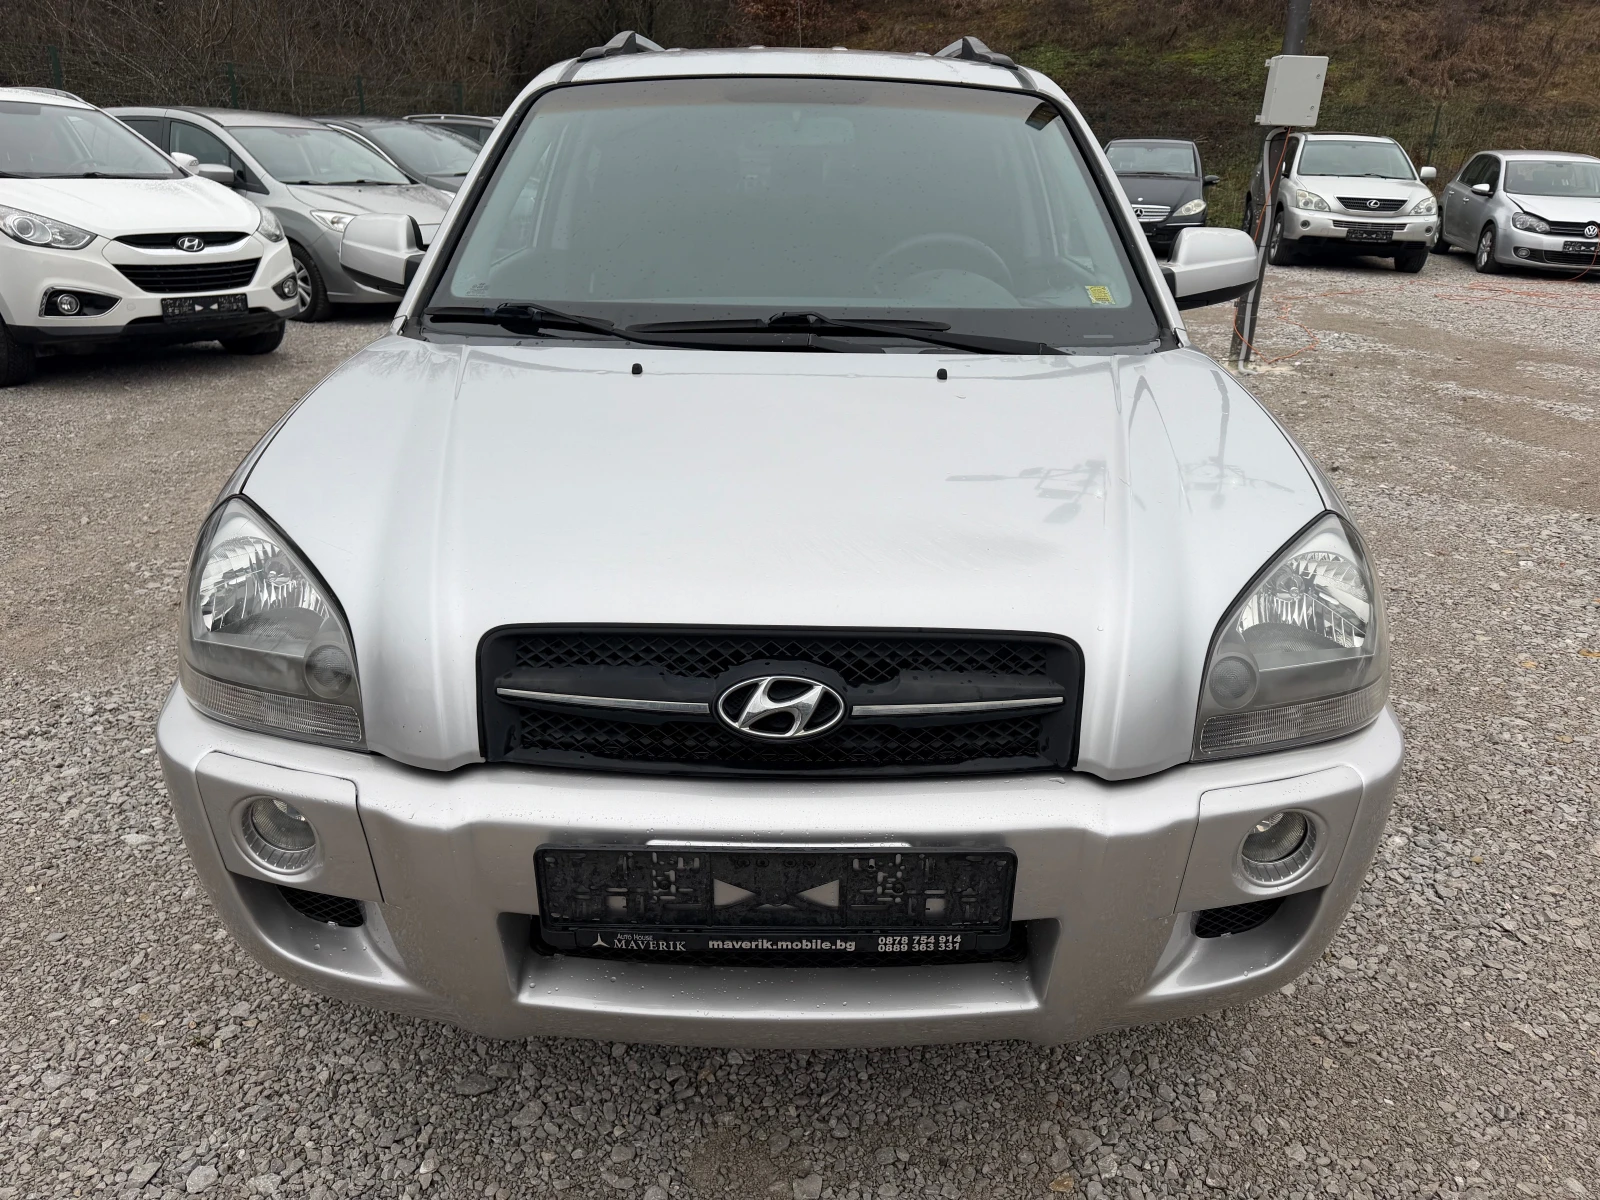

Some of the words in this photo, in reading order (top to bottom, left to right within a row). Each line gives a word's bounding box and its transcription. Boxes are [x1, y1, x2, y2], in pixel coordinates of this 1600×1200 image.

[878, 936, 909, 944] 0878
[912, 935, 935, 944] 754
[938, 934, 961, 943] 914
[613, 939, 686, 951] MAVERIK
[708, 938, 856, 952] maverik.mobile.bg
[878, 944, 908, 952] 0889
[911, 943, 935, 952] 363
[938, 942, 960, 951] 331
